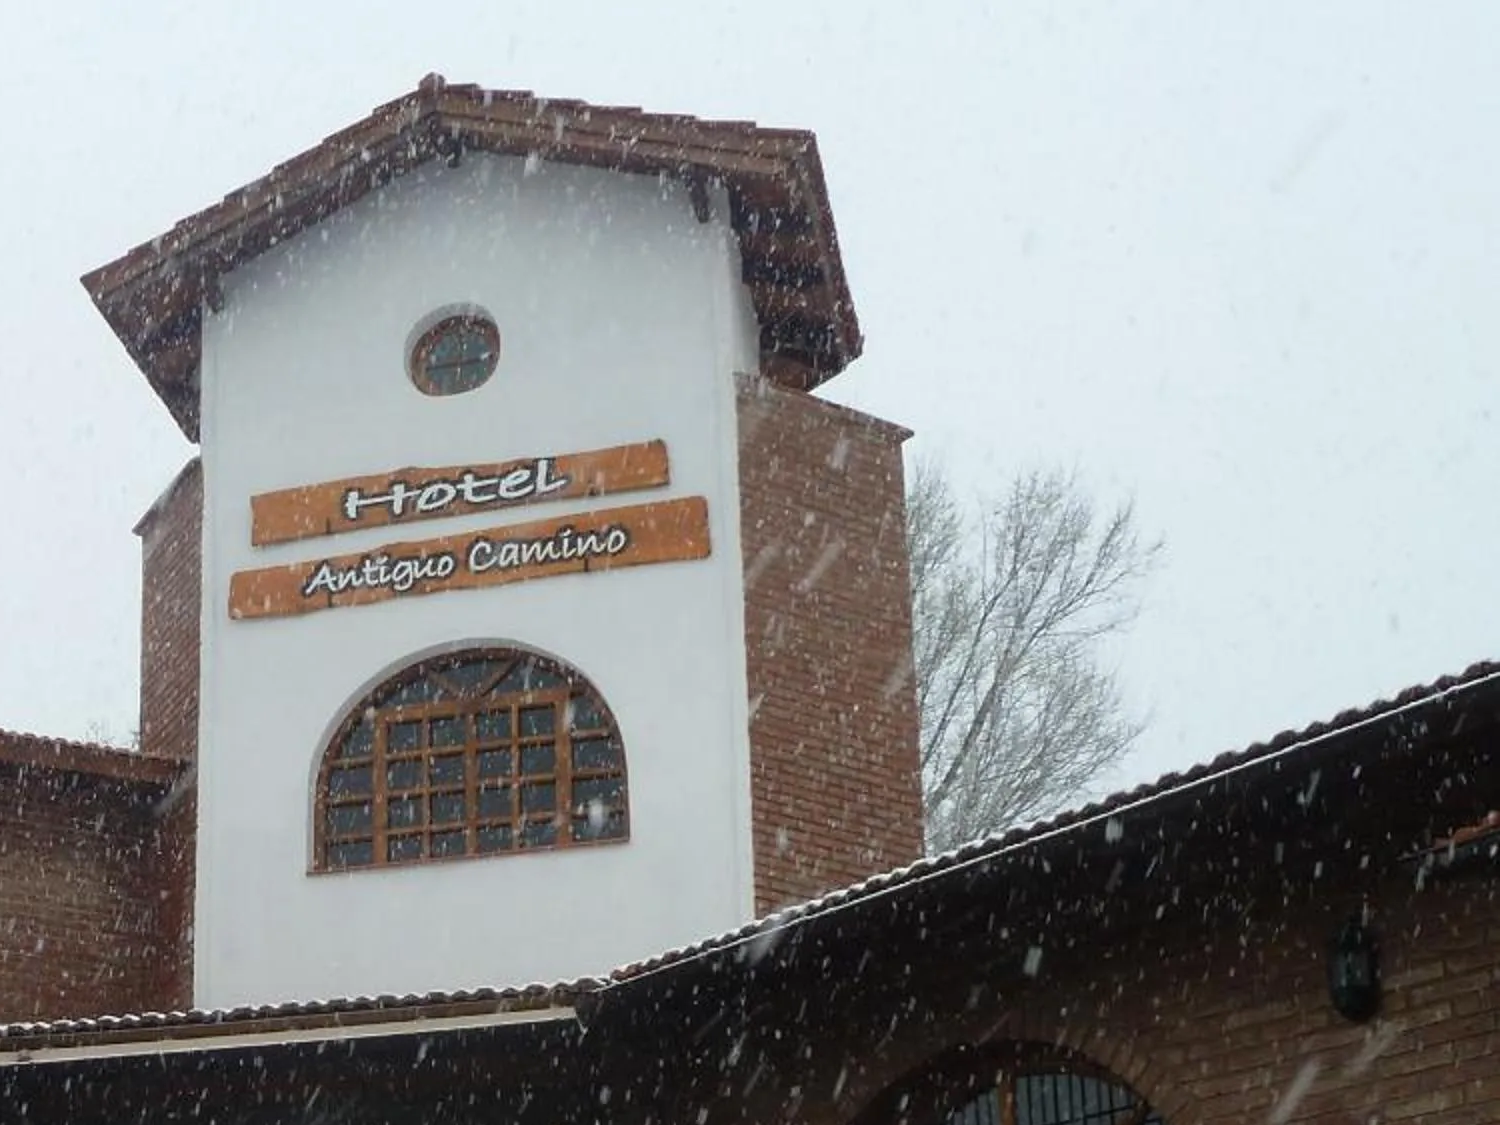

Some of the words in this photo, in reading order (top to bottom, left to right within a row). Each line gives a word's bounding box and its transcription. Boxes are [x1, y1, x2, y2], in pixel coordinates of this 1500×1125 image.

[343, 457, 567, 520] Hotel
[304, 554, 455, 596] Antiguo
[468, 526, 627, 573] Camino
